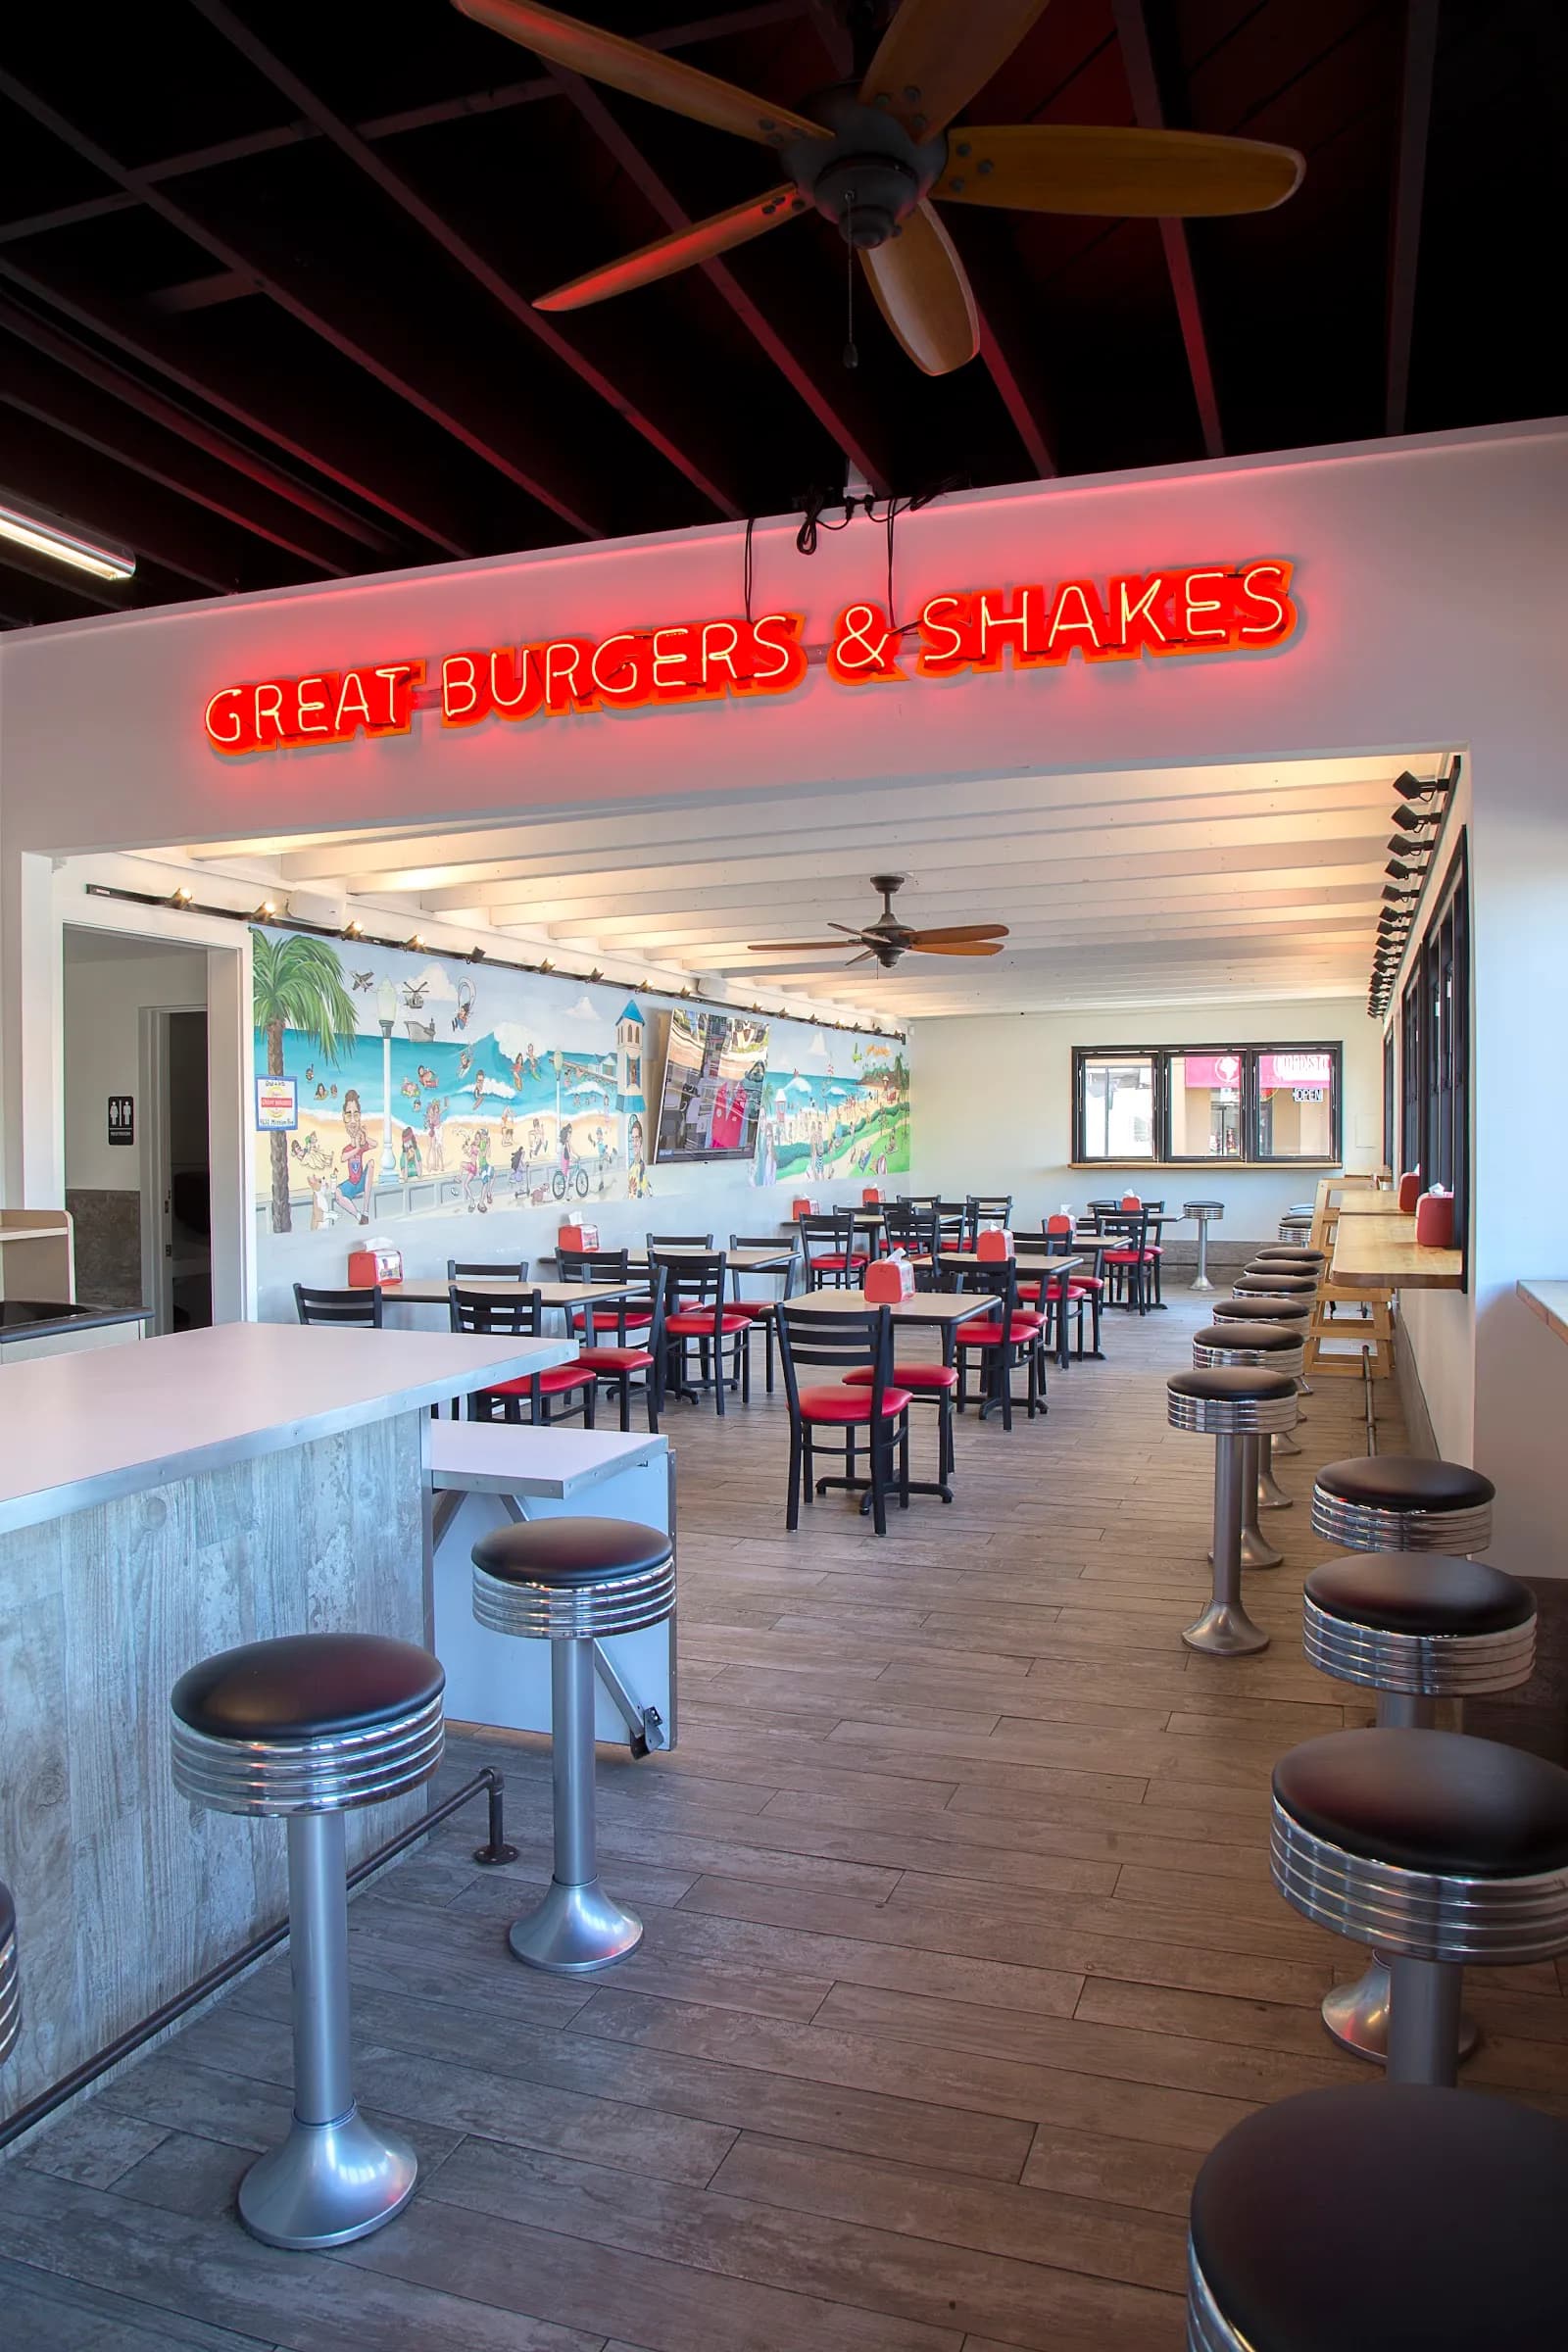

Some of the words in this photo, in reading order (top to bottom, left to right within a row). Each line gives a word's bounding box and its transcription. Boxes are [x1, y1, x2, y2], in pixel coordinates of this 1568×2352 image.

[204, 662, 421, 751] GREAT
[441, 613, 804, 723] BURGERS
[832, 603, 900, 678] &
[919, 562, 1294, 670] SHAKES
[1295, 1088, 1322, 1101] OPEN
